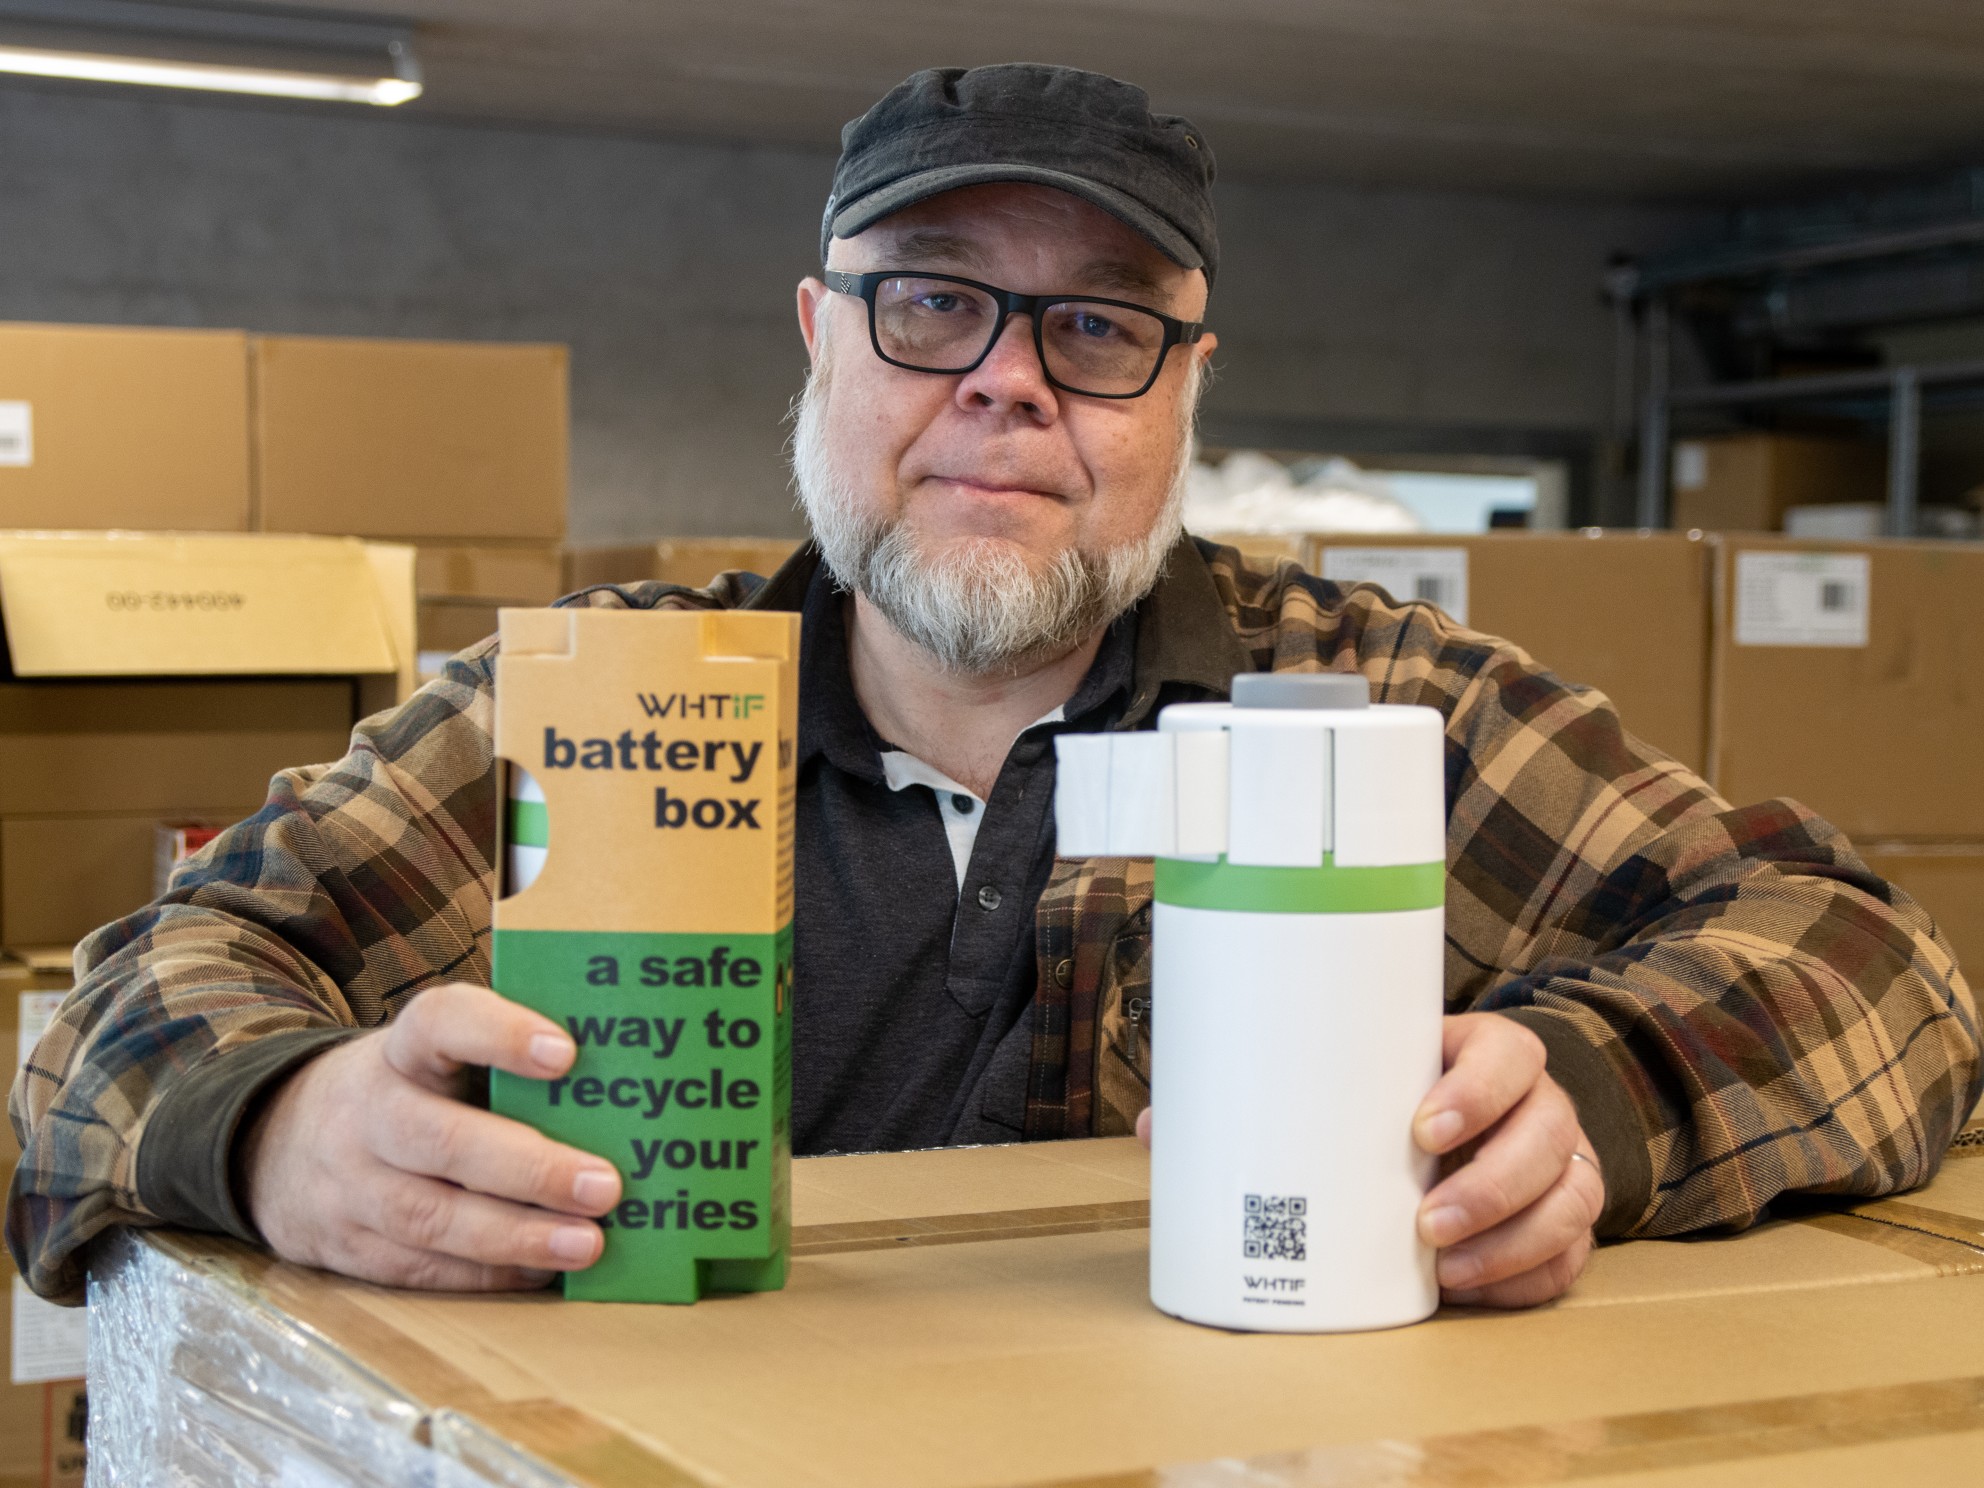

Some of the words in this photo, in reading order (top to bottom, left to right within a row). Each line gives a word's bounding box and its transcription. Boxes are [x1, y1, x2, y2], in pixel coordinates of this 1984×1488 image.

[543, 727, 763, 782] battery
[654, 787, 761, 829] box
[586, 954, 619, 987] a
[639, 947, 762, 988] safe
[566, 1015, 685, 1058] way
[703, 1009, 761, 1049] to
[548, 1069, 760, 1119] recycle
[630, 1138, 759, 1180] your
[601, 1190, 758, 1231] eries
